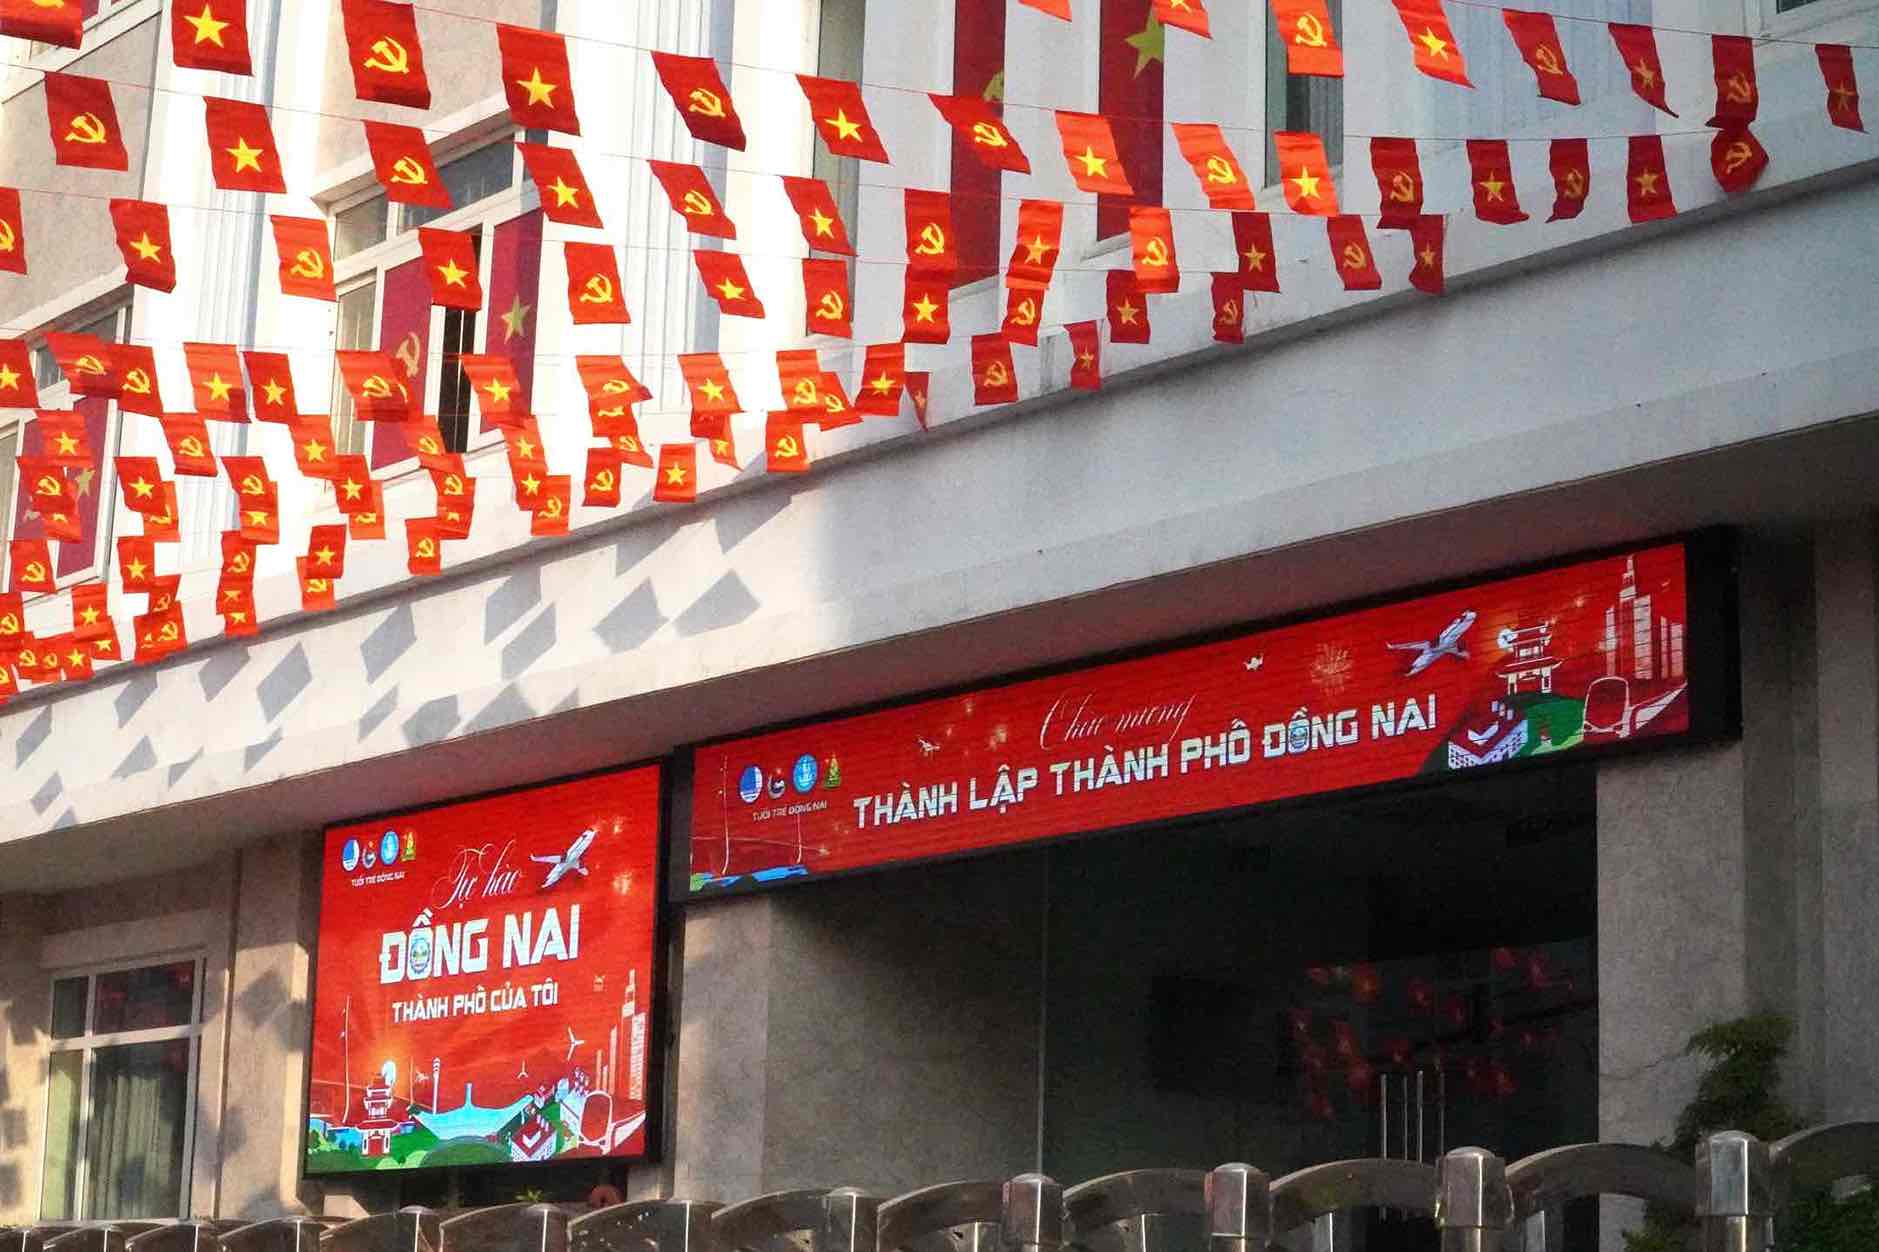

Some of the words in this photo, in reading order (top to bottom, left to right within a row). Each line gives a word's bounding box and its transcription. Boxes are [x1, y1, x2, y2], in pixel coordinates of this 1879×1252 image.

[853, 781, 958, 829] THÀNH
[969, 764, 1038, 814] LẬP
[1049, 745, 1169, 796] THÀNH
[1180, 718, 1250, 774] PHỐ
[1261, 706, 1360, 758] ĐỒNG
[1371, 694, 1436, 740] NAI
[379, 907, 489, 984] ĐỒNG
[502, 903, 580, 968] NAI
[392, 993, 449, 1024] THÀNH
[490, 980, 528, 1012] CỦA
[531, 976, 560, 1007] TÔI
